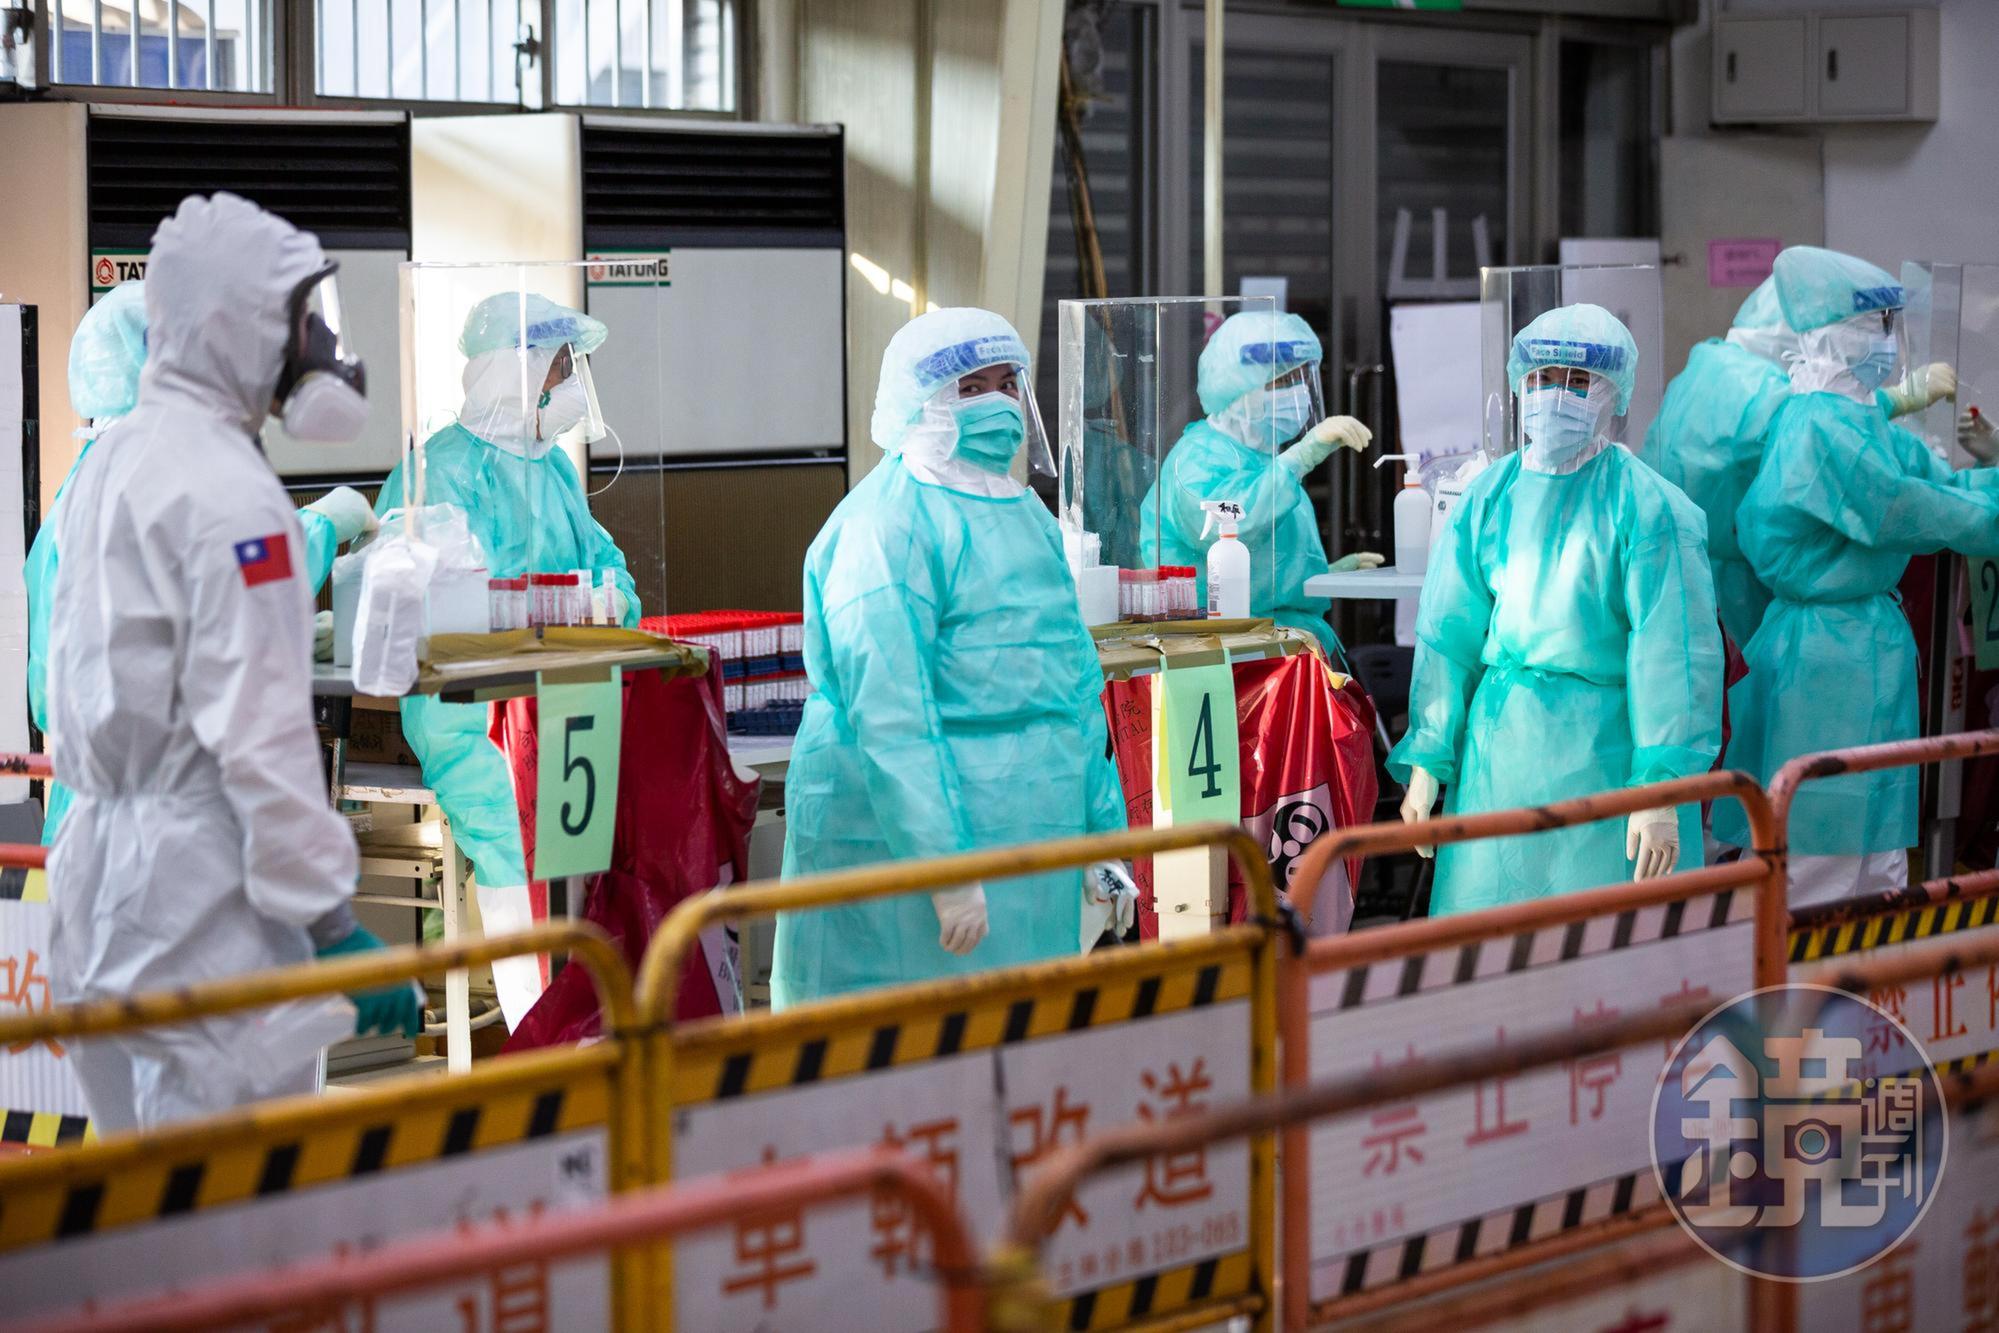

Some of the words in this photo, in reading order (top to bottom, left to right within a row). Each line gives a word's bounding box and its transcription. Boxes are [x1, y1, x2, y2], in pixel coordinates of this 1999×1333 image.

[116, 262, 148, 281] TAT
[605, 259, 668, 277] TATUNG
[561, 715, 595, 836] 5
[1188, 692, 1222, 799] 4
[1866, 965, 1999, 1055] 禁止
